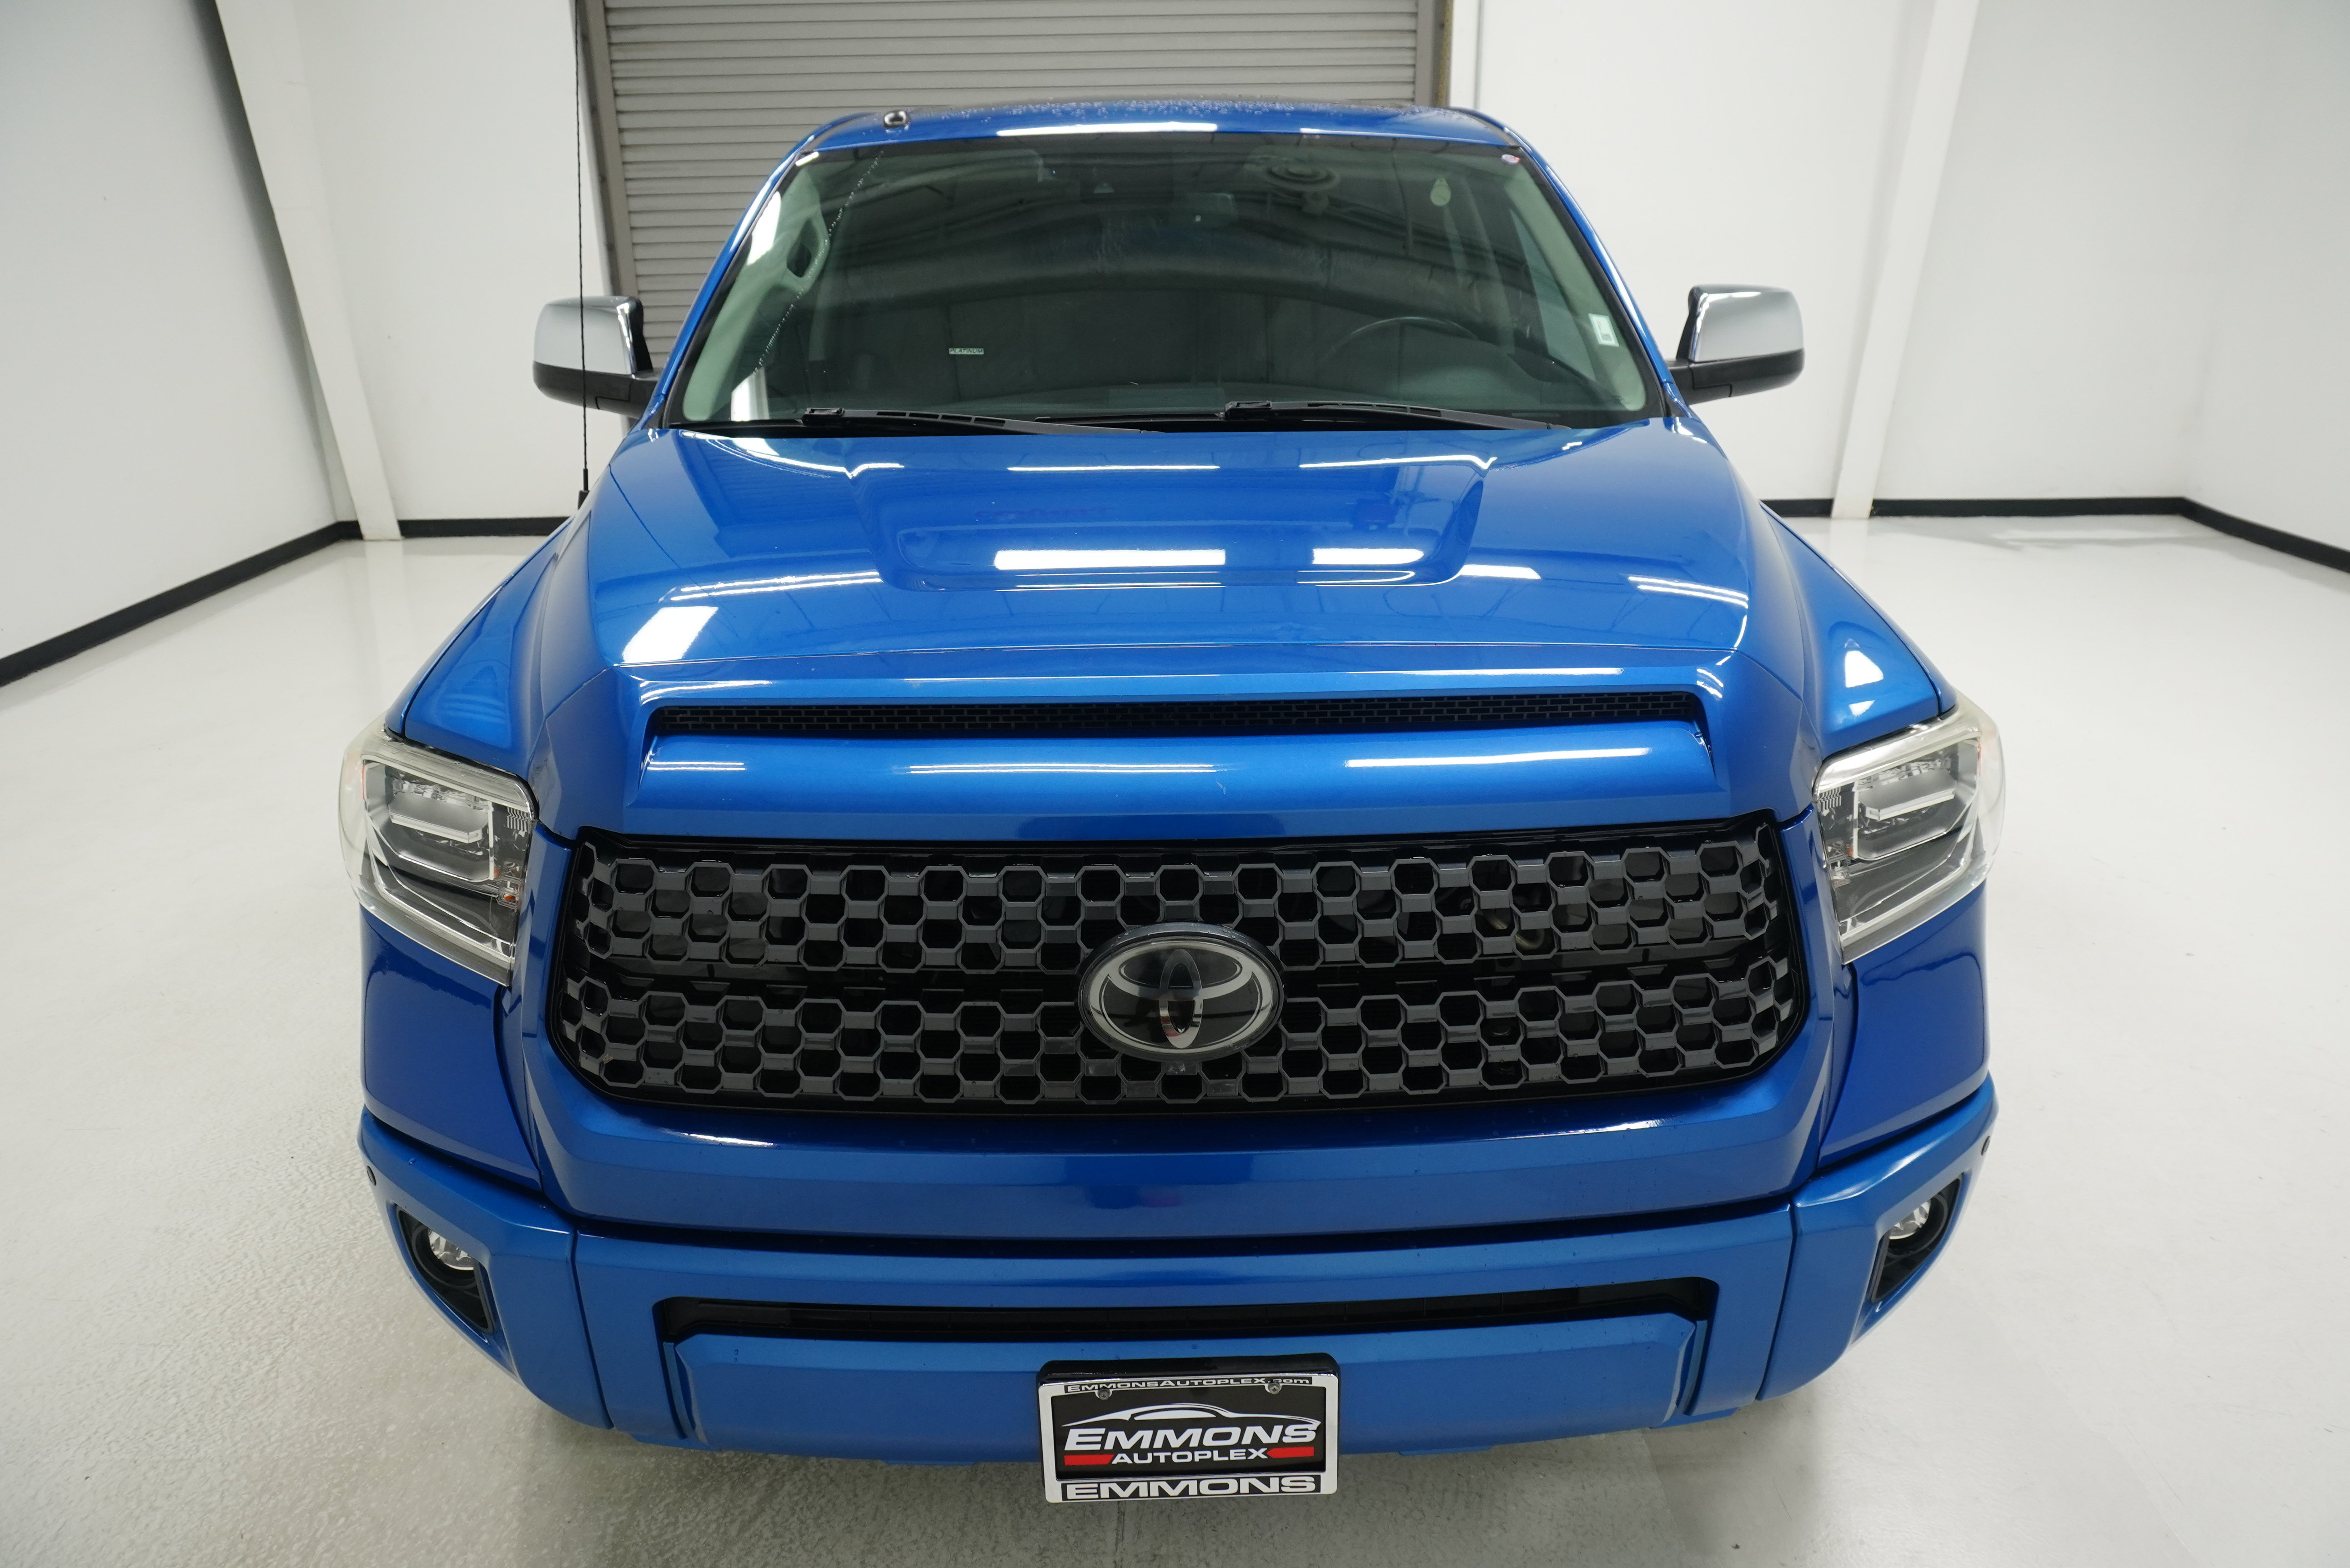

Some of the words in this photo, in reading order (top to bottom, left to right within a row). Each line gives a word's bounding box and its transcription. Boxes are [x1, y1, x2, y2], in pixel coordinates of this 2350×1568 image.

[1065, 1424, 1317, 1451] EMMONS
[1111, 1448, 1269, 1464] AUTOPLEX
[1066, 1476, 1316, 1500] EMMONS
